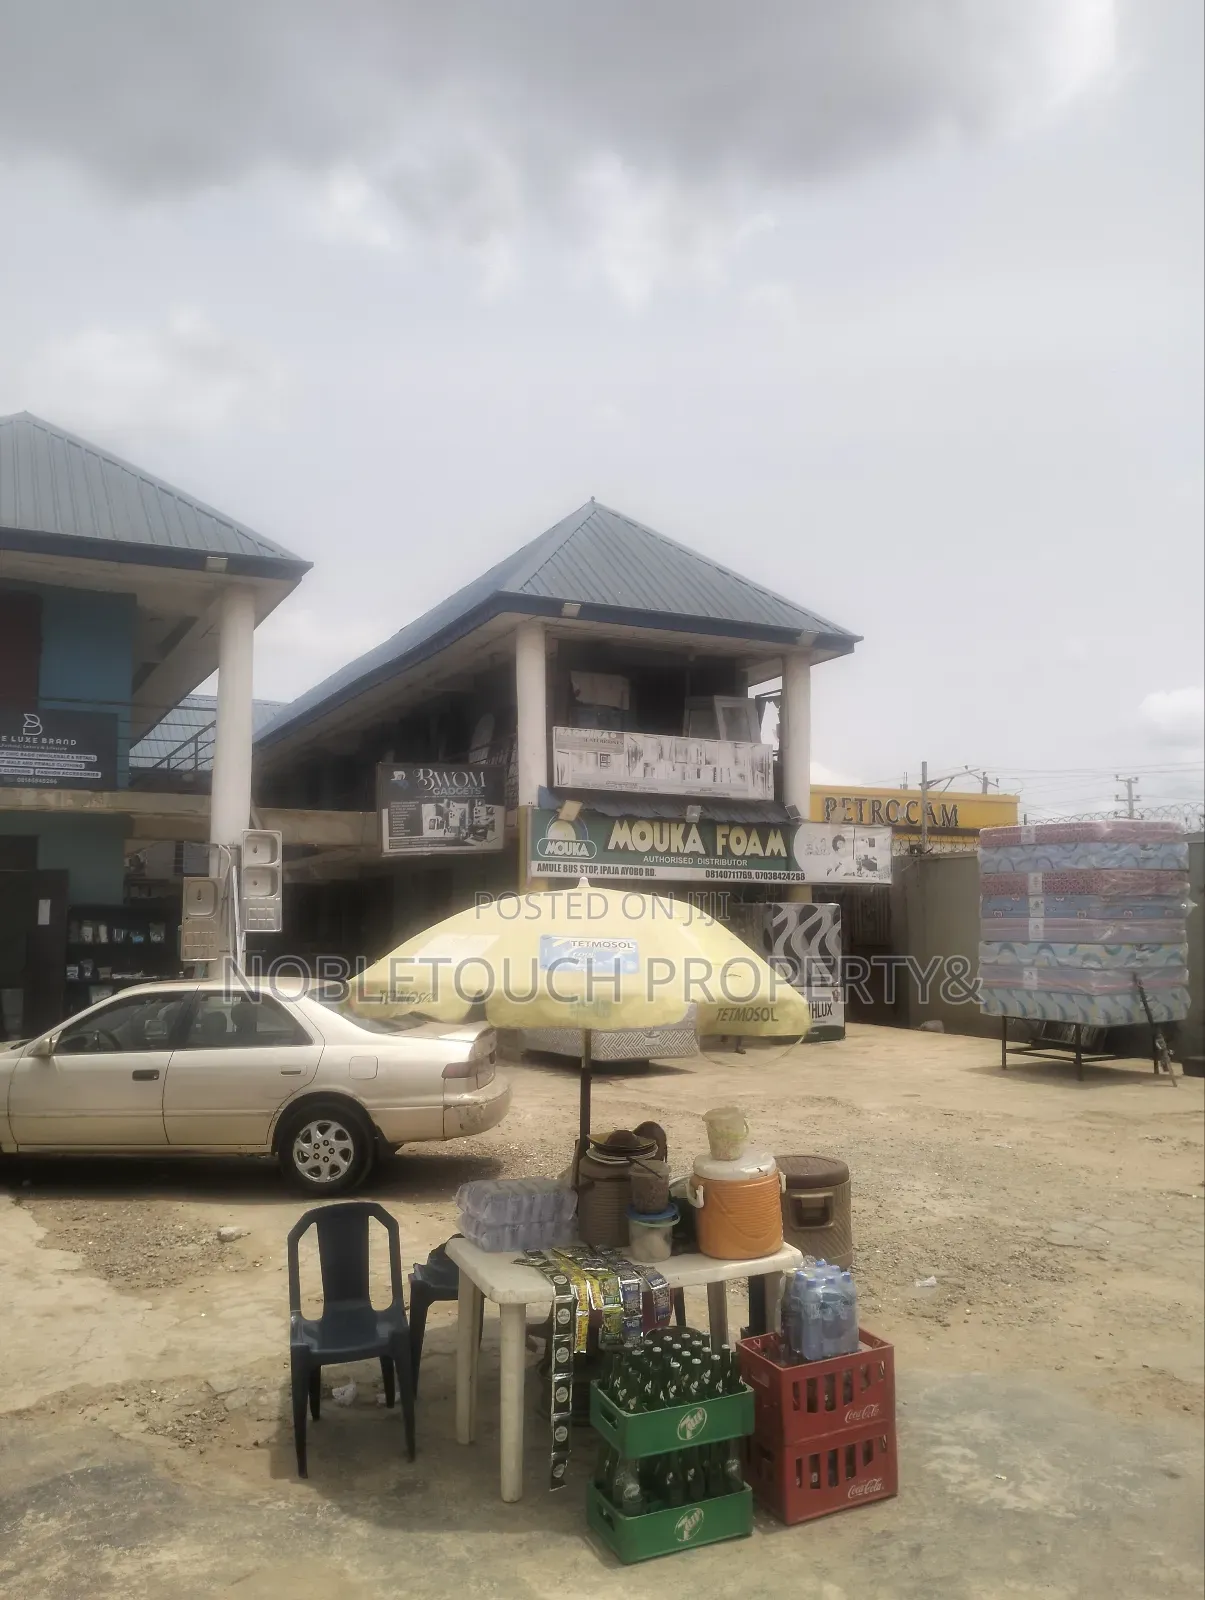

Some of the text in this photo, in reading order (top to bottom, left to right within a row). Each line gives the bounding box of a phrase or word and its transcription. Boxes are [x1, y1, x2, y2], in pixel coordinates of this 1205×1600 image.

[11, 735, 39, 744] LUXE
[42, 737, 77, 746] BRAND
[62, 770, 99, 778] ACCESSORIES
[413, 768, 487, 790] BWOM
[432, 787, 482, 796] GADGETS
[825, 796, 960, 828] PETROCAM
[607, 819, 788, 857] MOUKA FOAM
[544, 840, 590, 857] MOUKA
[643, 855, 748, 867] AUTHORISED DISTRIBUTOR
[536, 863, 657, 877] AMULE BUS STOP, IPAJA AYOBO RD.
[570, 940, 634, 949] TETMOSOL
[716, 1006, 779, 1022] TETMOSOL
[808, 1000, 833, 1019] HLUX
